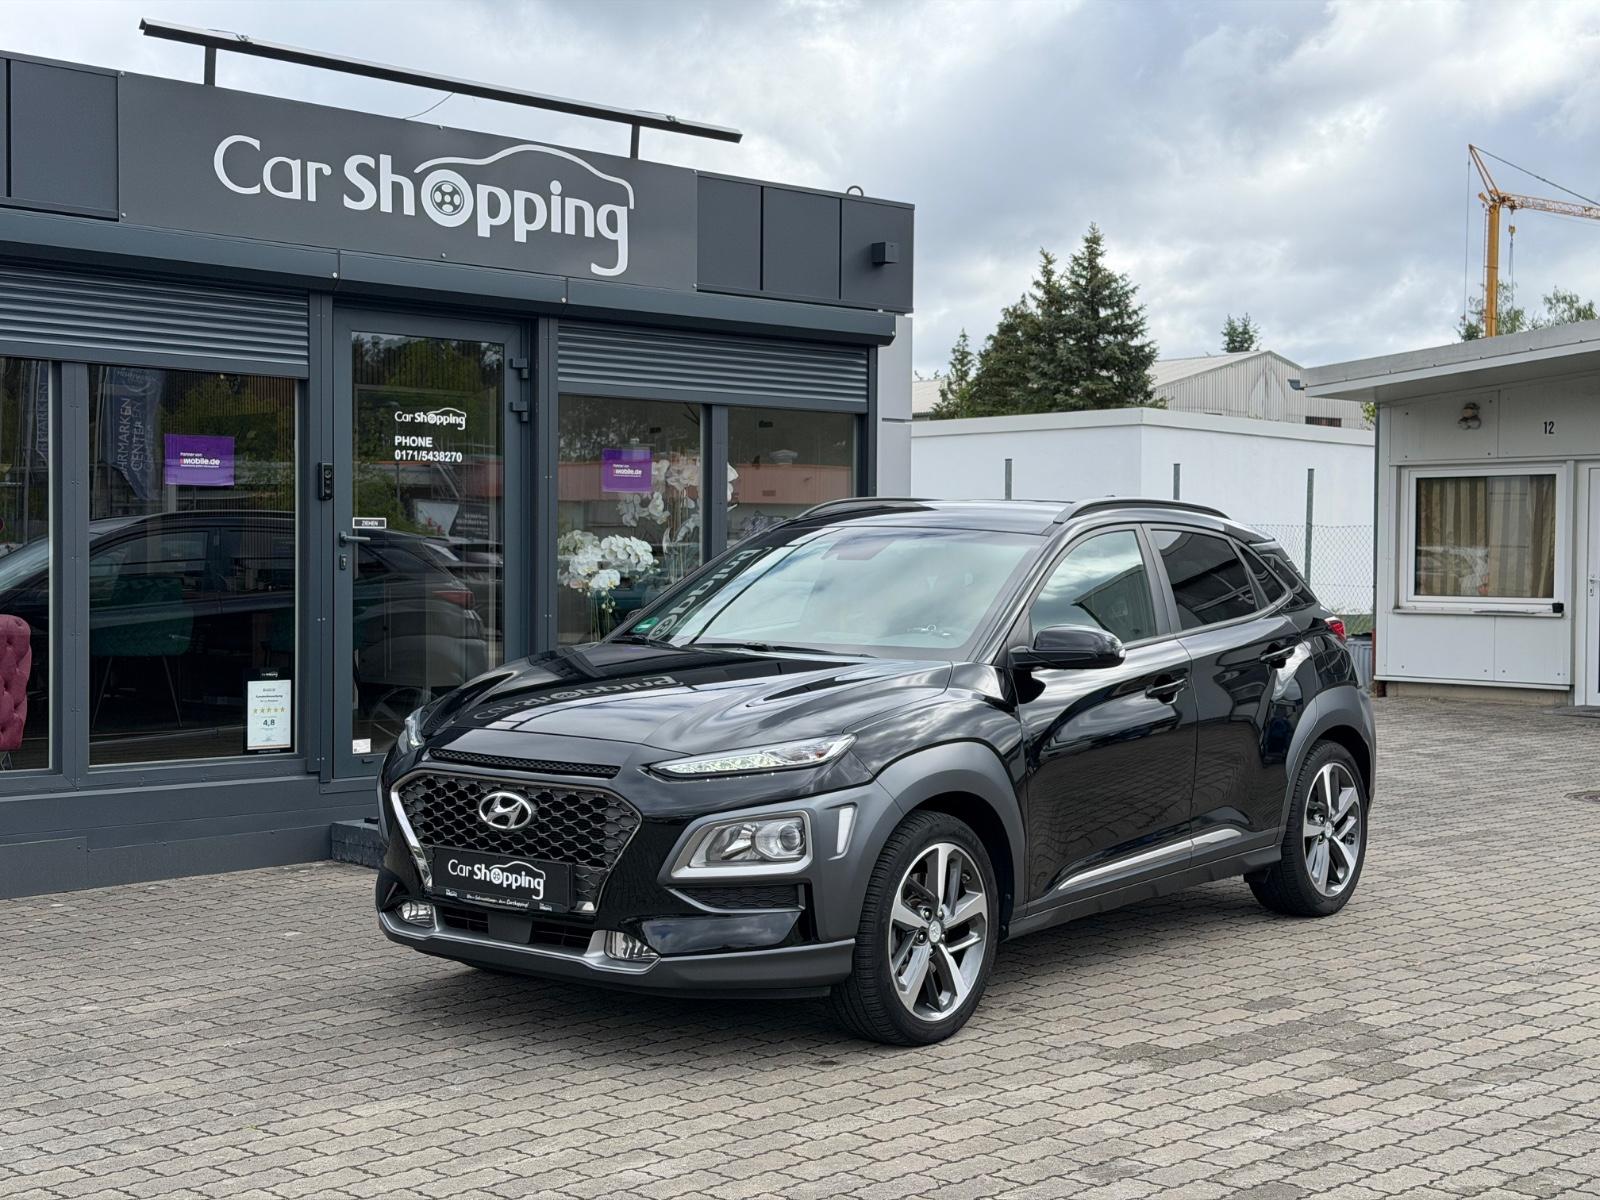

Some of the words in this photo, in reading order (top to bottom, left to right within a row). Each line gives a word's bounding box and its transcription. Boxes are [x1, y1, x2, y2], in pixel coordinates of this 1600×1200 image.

[213, 134, 332, 202] Car
[343, 152, 630, 277] Shopping
[394, 410, 413, 422] Car
[414, 411, 466, 430] Shopping
[1543, 420, 1555, 435] 12
[394, 435, 433, 448] PHONE
[394, 449, 463, 463] 0171/5438270
[448, 859, 472, 877] Car
[473, 863, 545, 900] Shopping
